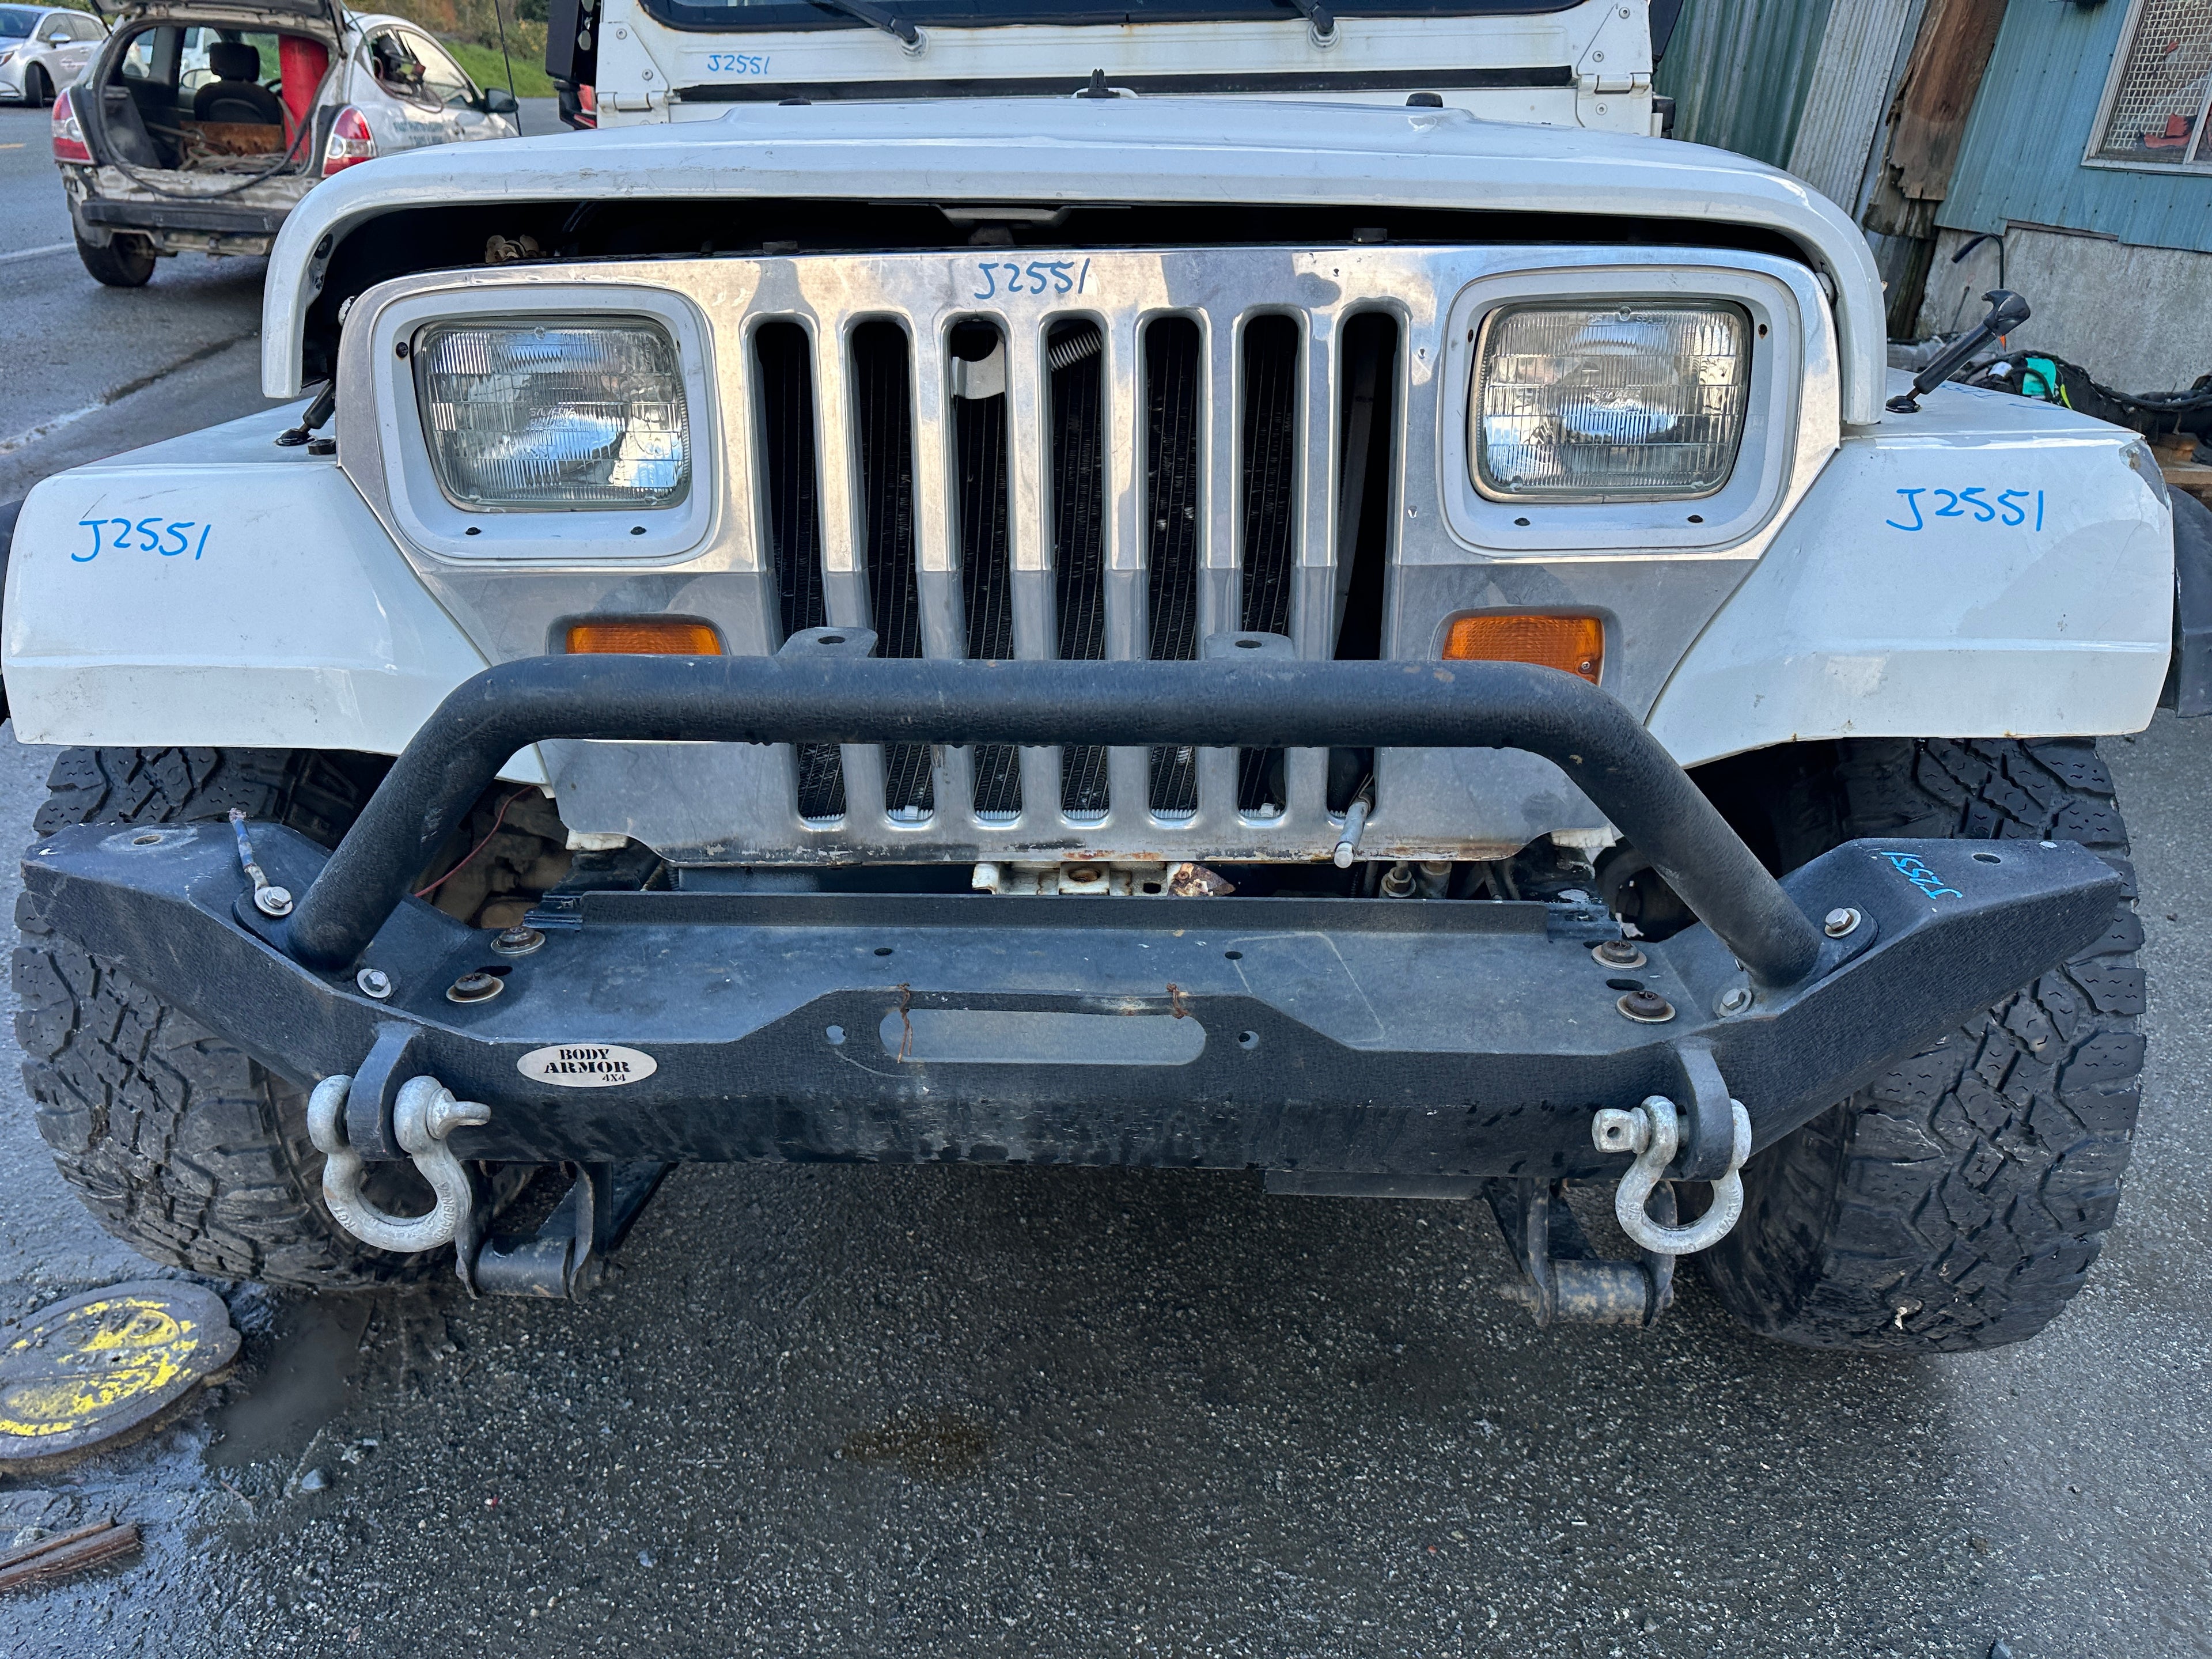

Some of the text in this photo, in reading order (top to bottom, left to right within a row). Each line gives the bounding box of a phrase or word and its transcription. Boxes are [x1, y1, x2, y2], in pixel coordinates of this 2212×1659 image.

[708, 55, 770, 74] J2551
[974, 258, 1090, 300] J2551
[1885, 487, 2044, 532] J2551
[71, 517, 211, 563] J2551
[1880, 851, 1963, 900] J2551
[544, 1061, 631, 1074] ARMOR
[559, 1048, 609, 1060] BODY
